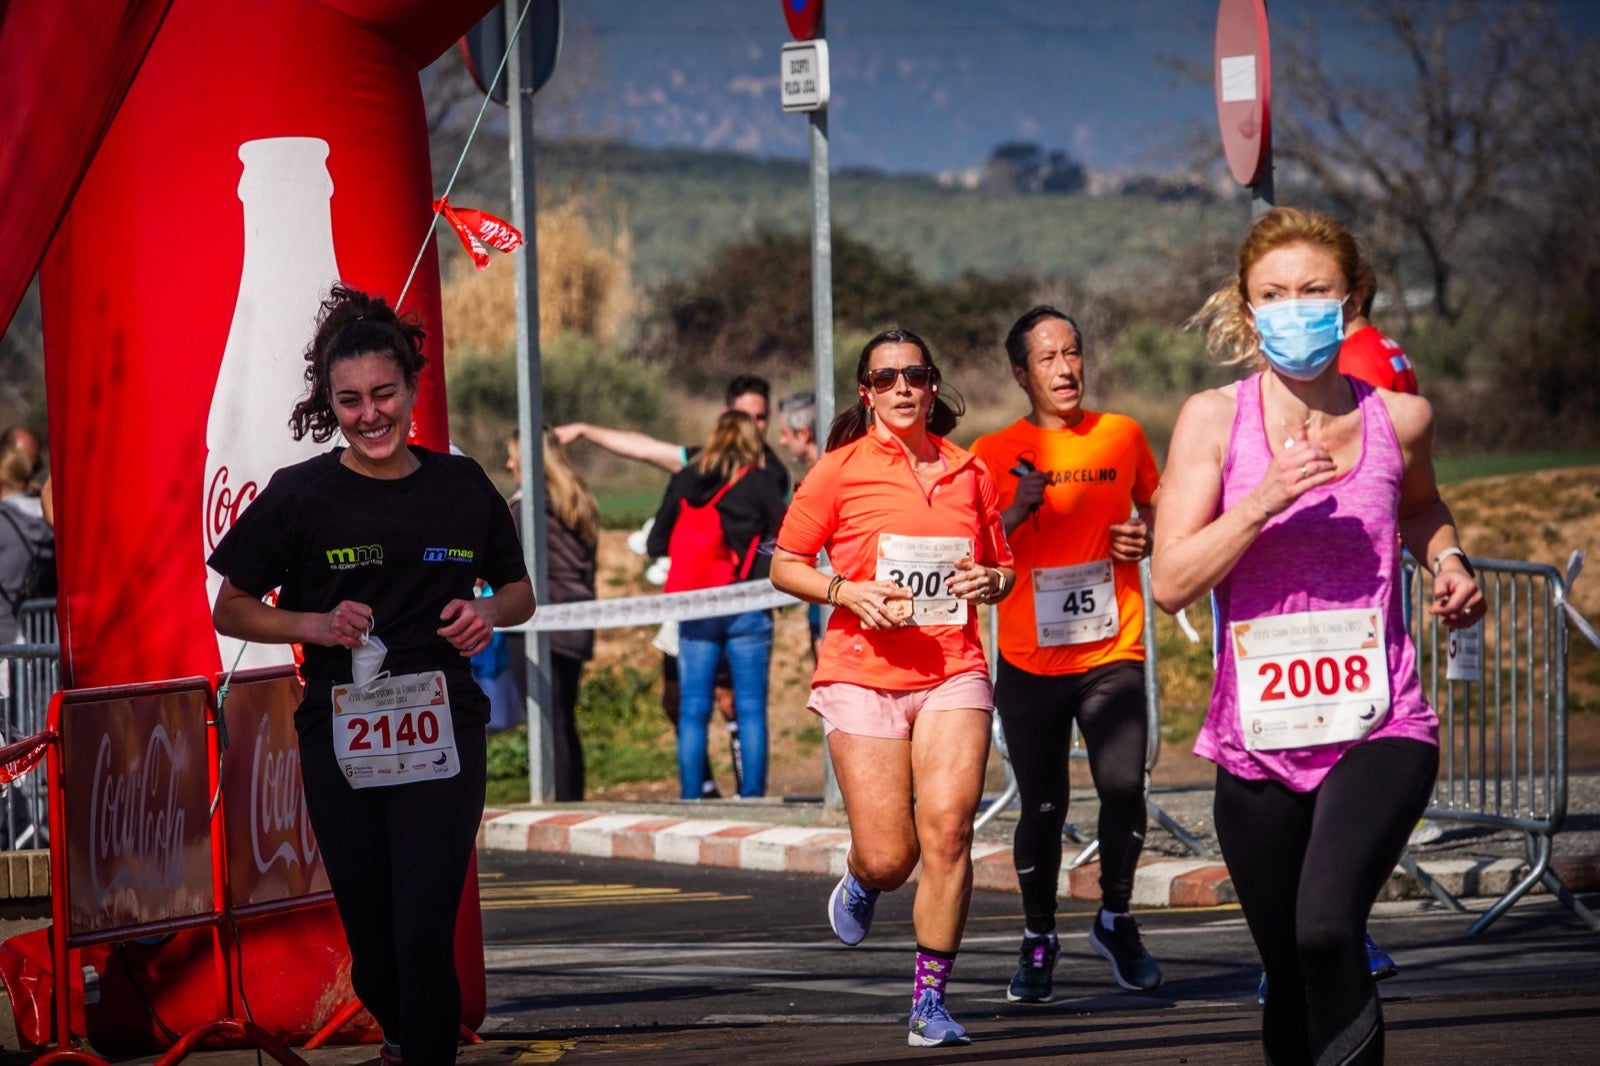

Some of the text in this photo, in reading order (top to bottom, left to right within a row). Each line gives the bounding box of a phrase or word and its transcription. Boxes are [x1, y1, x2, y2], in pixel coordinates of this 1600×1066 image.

[1048, 468, 1117, 484] ARCELINO
[1062, 589, 1096, 616] 45
[1258, 655, 1371, 702] 2008
[347, 710, 439, 752] 2140
